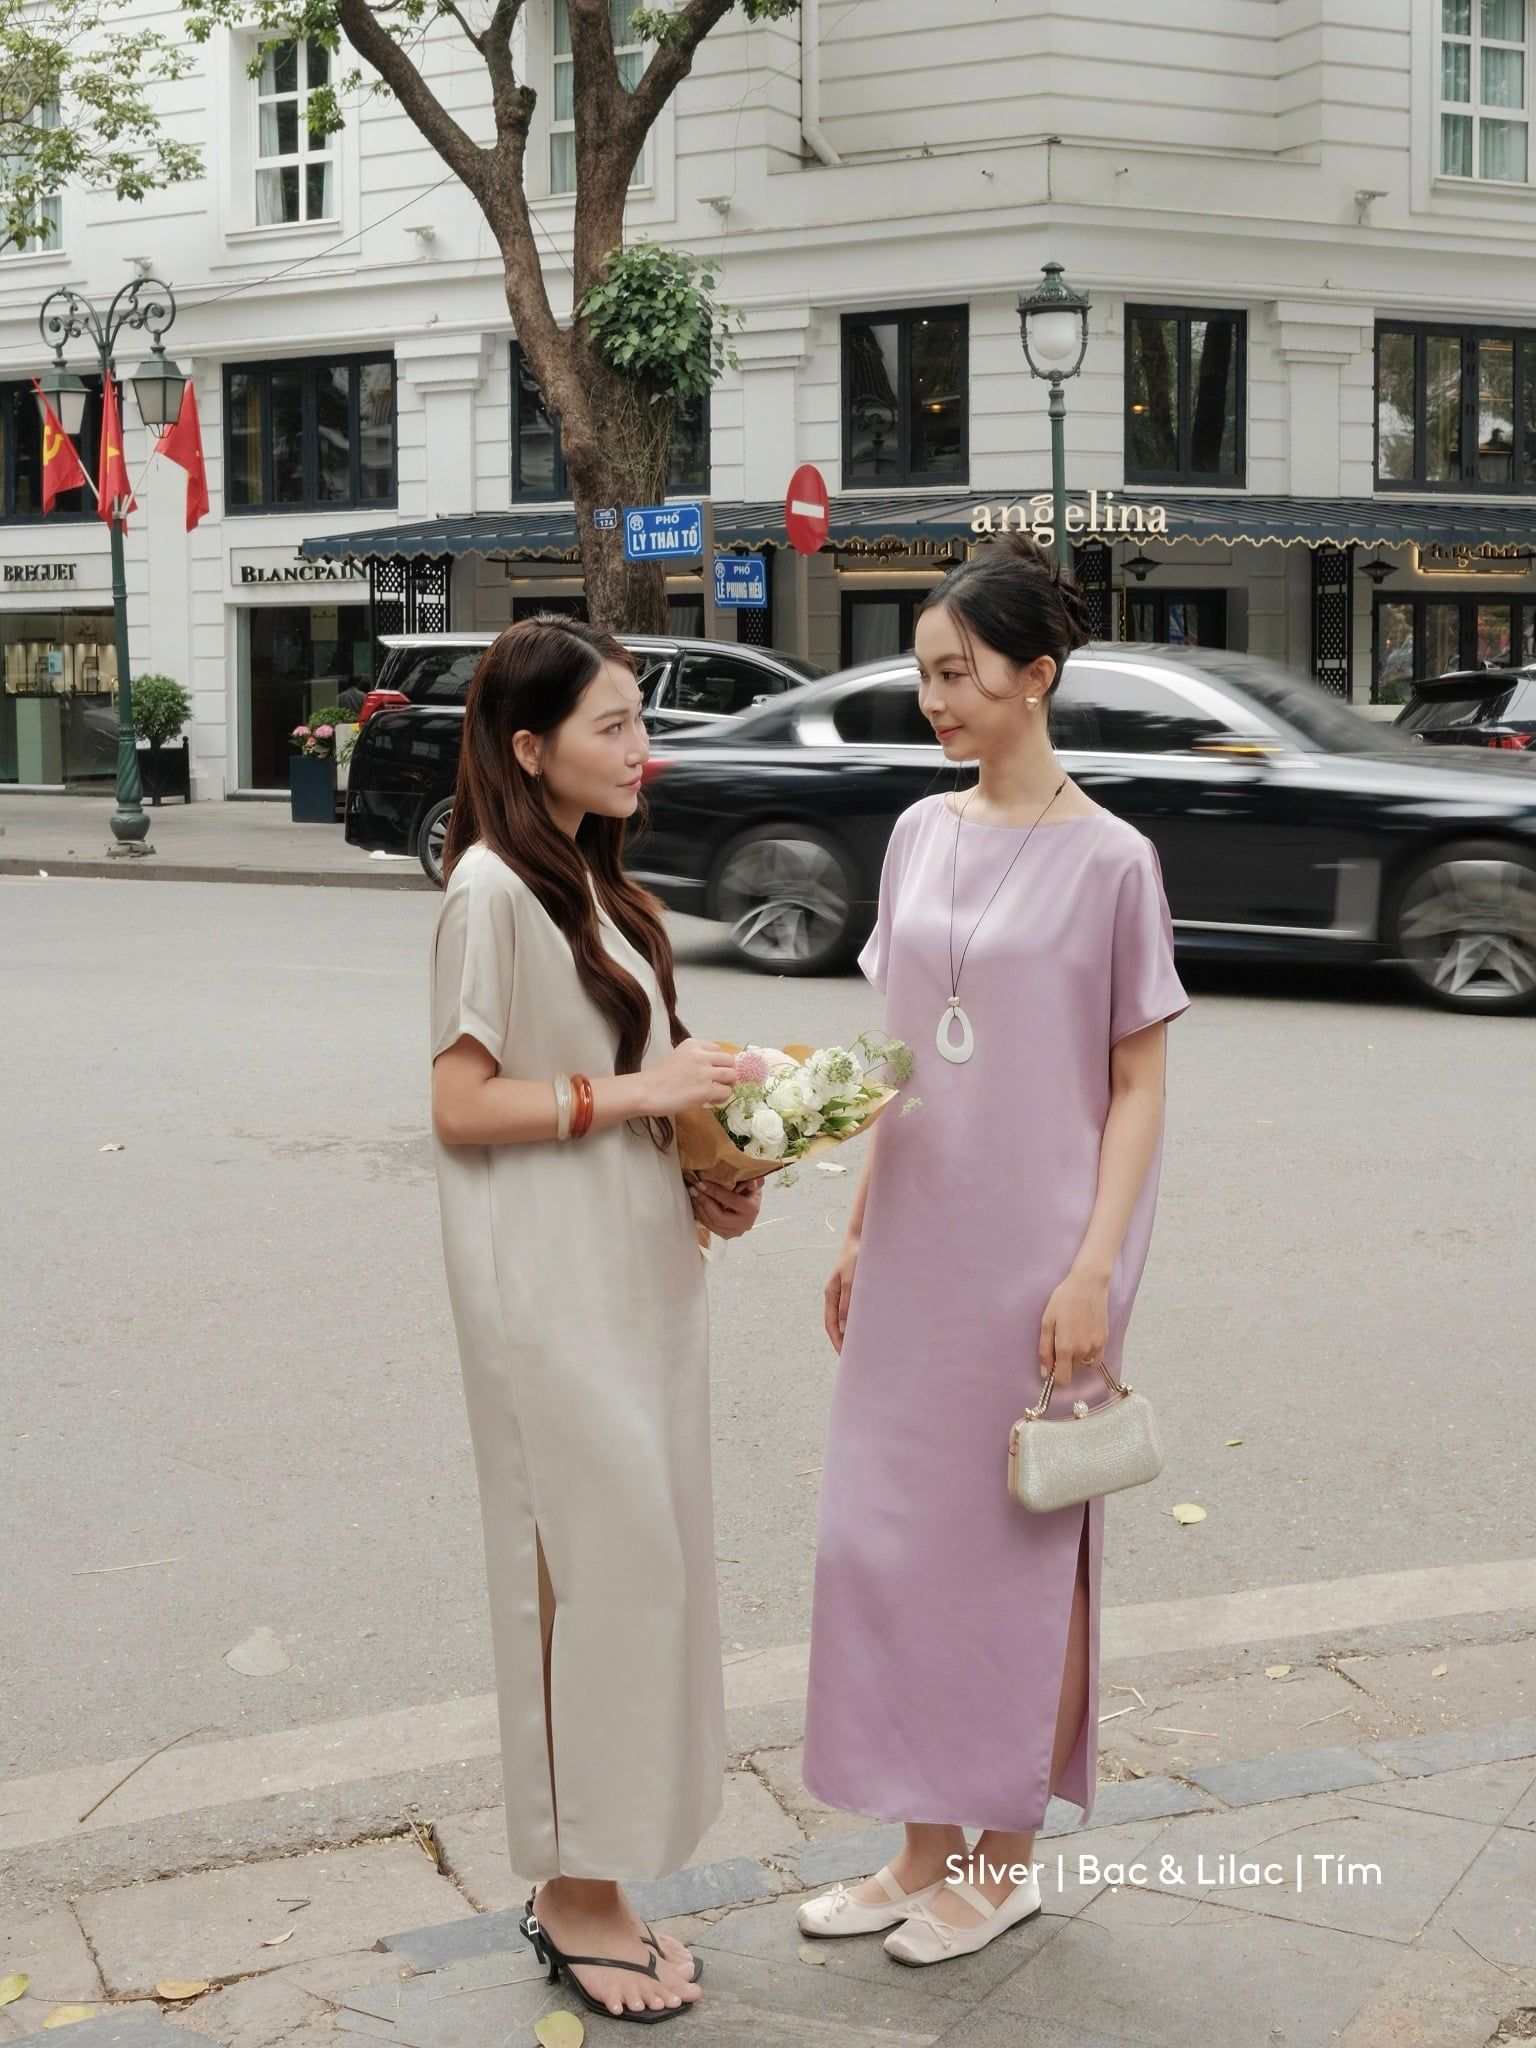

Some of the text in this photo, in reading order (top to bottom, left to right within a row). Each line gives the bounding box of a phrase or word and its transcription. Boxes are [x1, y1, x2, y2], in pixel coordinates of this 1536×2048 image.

[655, 510, 680, 525] PHỐ
[970, 489, 1169, 547] angelina
[632, 521, 698, 551] LÝ THÁI TỔ
[3, 563, 77, 582] BREGUET
[733, 562, 751, 575] PHỐ
[716, 578, 726, 599] LÊ
